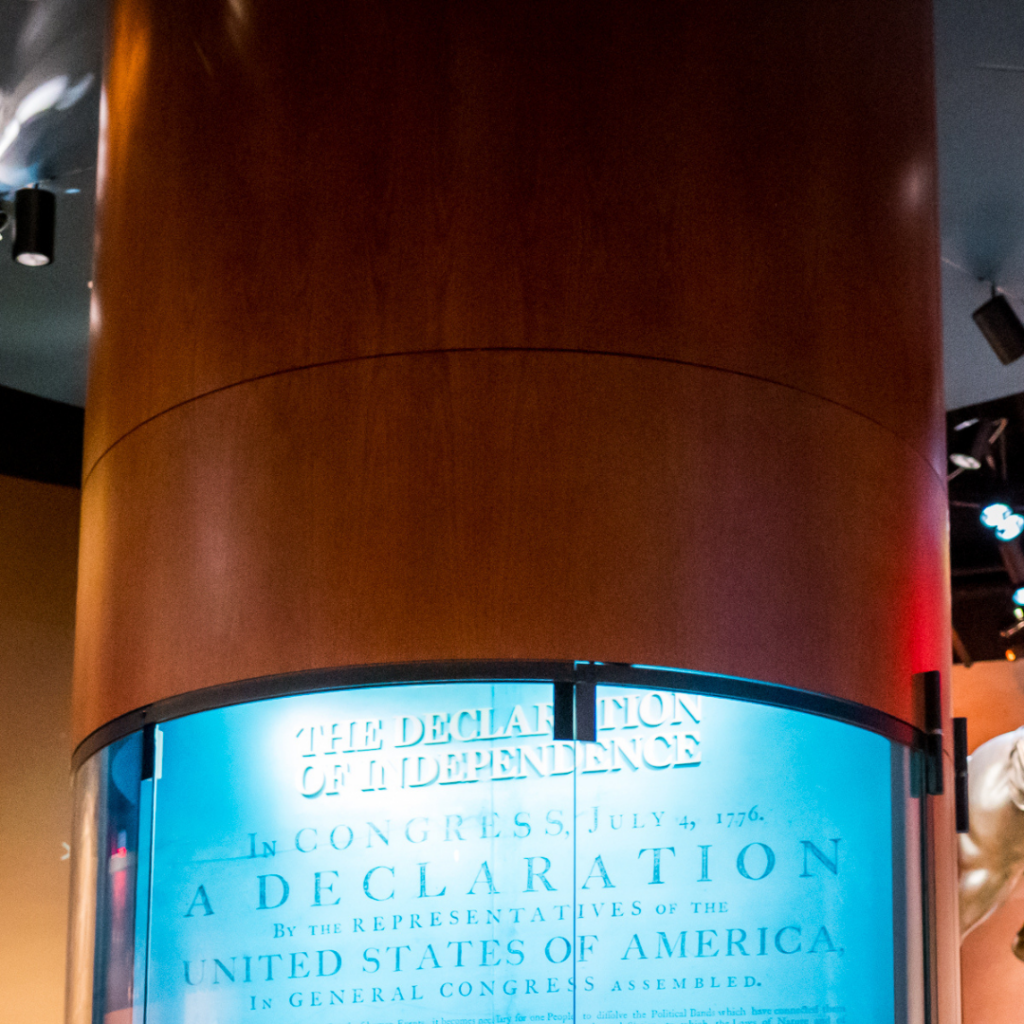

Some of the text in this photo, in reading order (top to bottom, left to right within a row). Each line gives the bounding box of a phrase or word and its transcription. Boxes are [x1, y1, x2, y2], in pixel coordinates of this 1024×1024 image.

[296, 692, 704, 760] THE DECLARTION
[299, 731, 704, 799] OF INDEPENDENCE
[294, 807, 570, 854] CONGRESS,
[679, 812, 697, 830] 4,
[715, 806, 765, 825] 1776.
[184, 837, 843, 918] A DECLARATION
[309, 921, 342, 937] THE
[352, 898, 643, 933] REPRESENTATIVES
[656, 901, 677, 916] OF
[690, 897, 729, 914] THE
[183, 924, 846, 985] UNITED STATES OF AMERICA,
[288, 985, 424, 1008] GENERAL
[438, 975, 595, 999] CONGRESS
[610, 974, 763, 992] ASSEMBLED.
